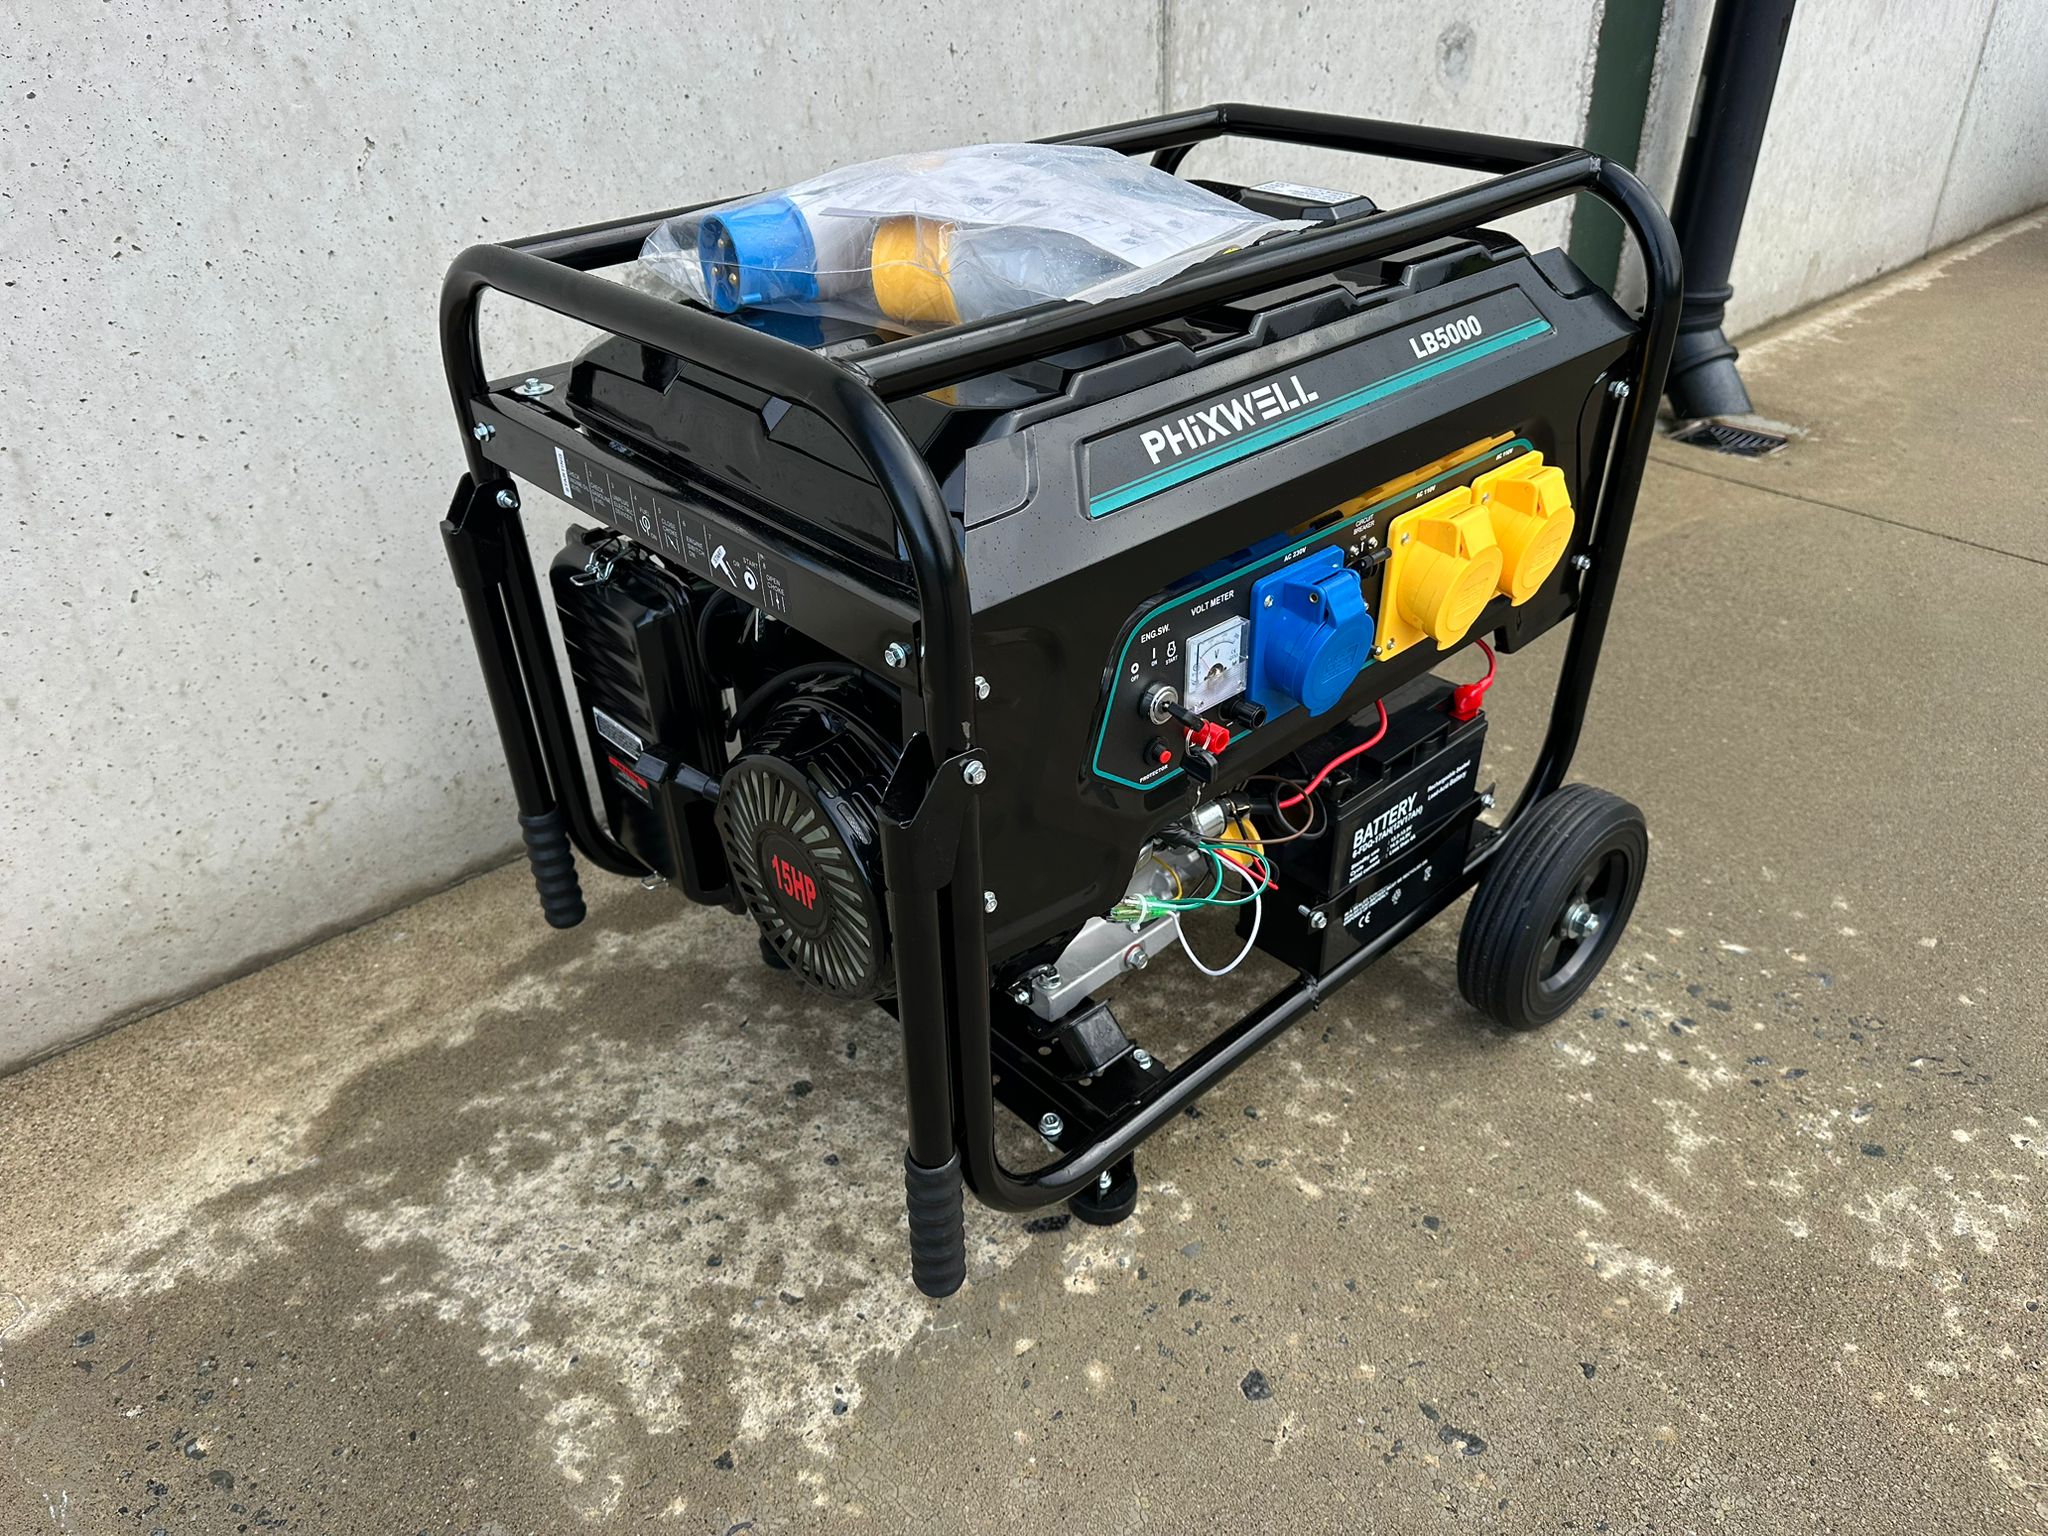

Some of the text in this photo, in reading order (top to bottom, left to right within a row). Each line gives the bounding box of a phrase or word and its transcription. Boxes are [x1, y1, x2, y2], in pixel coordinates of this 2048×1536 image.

[1409, 314, 1483, 359] LB5000
[1416, 490, 1424, 499] AC
[639, 506, 651, 518] FUEL
[1353, 520, 1376, 536] BREAKER
[1355, 513, 1374, 528] CIRCUIT
[1283, 546, 1307, 562] AC 230V
[742, 556, 758, 570] START
[766, 573, 781, 587] OPEN
[766, 581, 785, 597] CHOKE
[1190, 590, 1235, 617] VOLT METER
[1140, 623, 1171, 644] ENG.SW.
[1151, 659, 1158, 667] ON
[1165, 654, 1178, 666] START
[1130, 674, 1139, 682] OFF
[1139, 764, 1169, 783] PROTECTOR
[1353, 792, 1418, 850] BATTERY
[772, 854, 816, 910] 15HP
